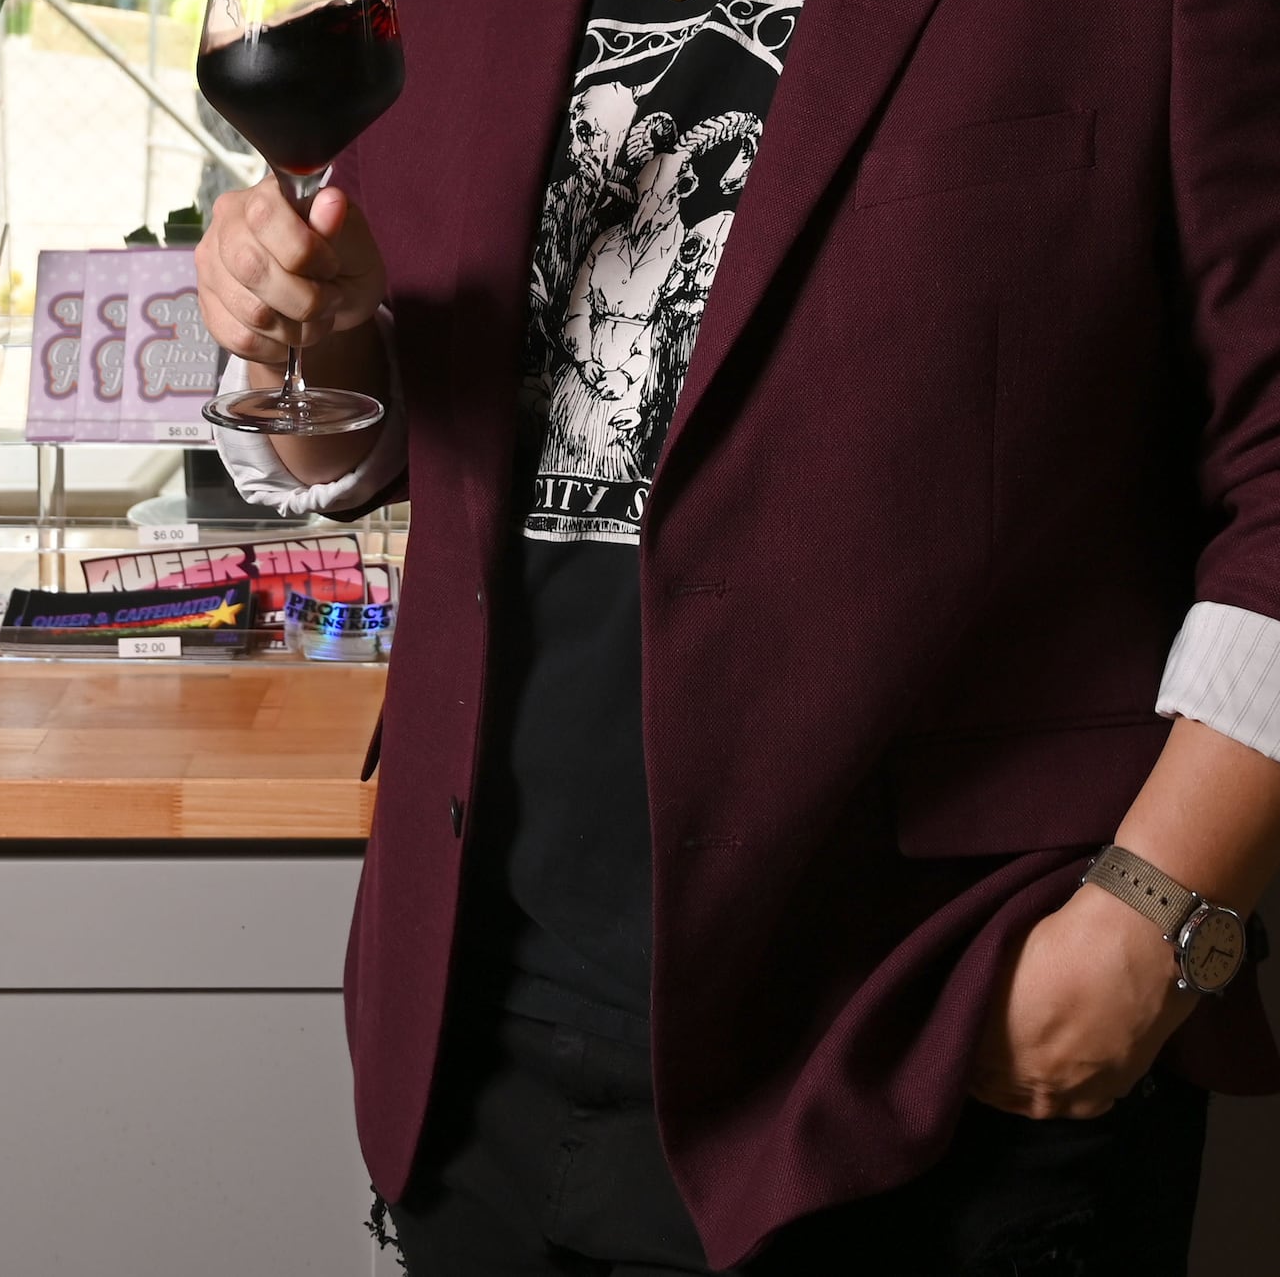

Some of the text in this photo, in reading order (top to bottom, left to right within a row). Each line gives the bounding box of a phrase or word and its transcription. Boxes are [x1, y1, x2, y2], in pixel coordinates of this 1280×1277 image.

[142, 342, 218, 366] Chose
[143, 365, 213, 392] Fam
[168, 426, 199, 437] $6.00
[625, 487, 650, 521] S
[153, 529, 184, 541] $6.00
[84, 546, 247, 594] QUEER
[253, 535, 361, 577] AND
[288, 590, 394, 620] PROTECT
[33, 611, 92, 628] QUEER
[93, 611, 109, 625] &
[286, 605, 346, 631] TRANS
[134, 642, 166, 653] $2.00
